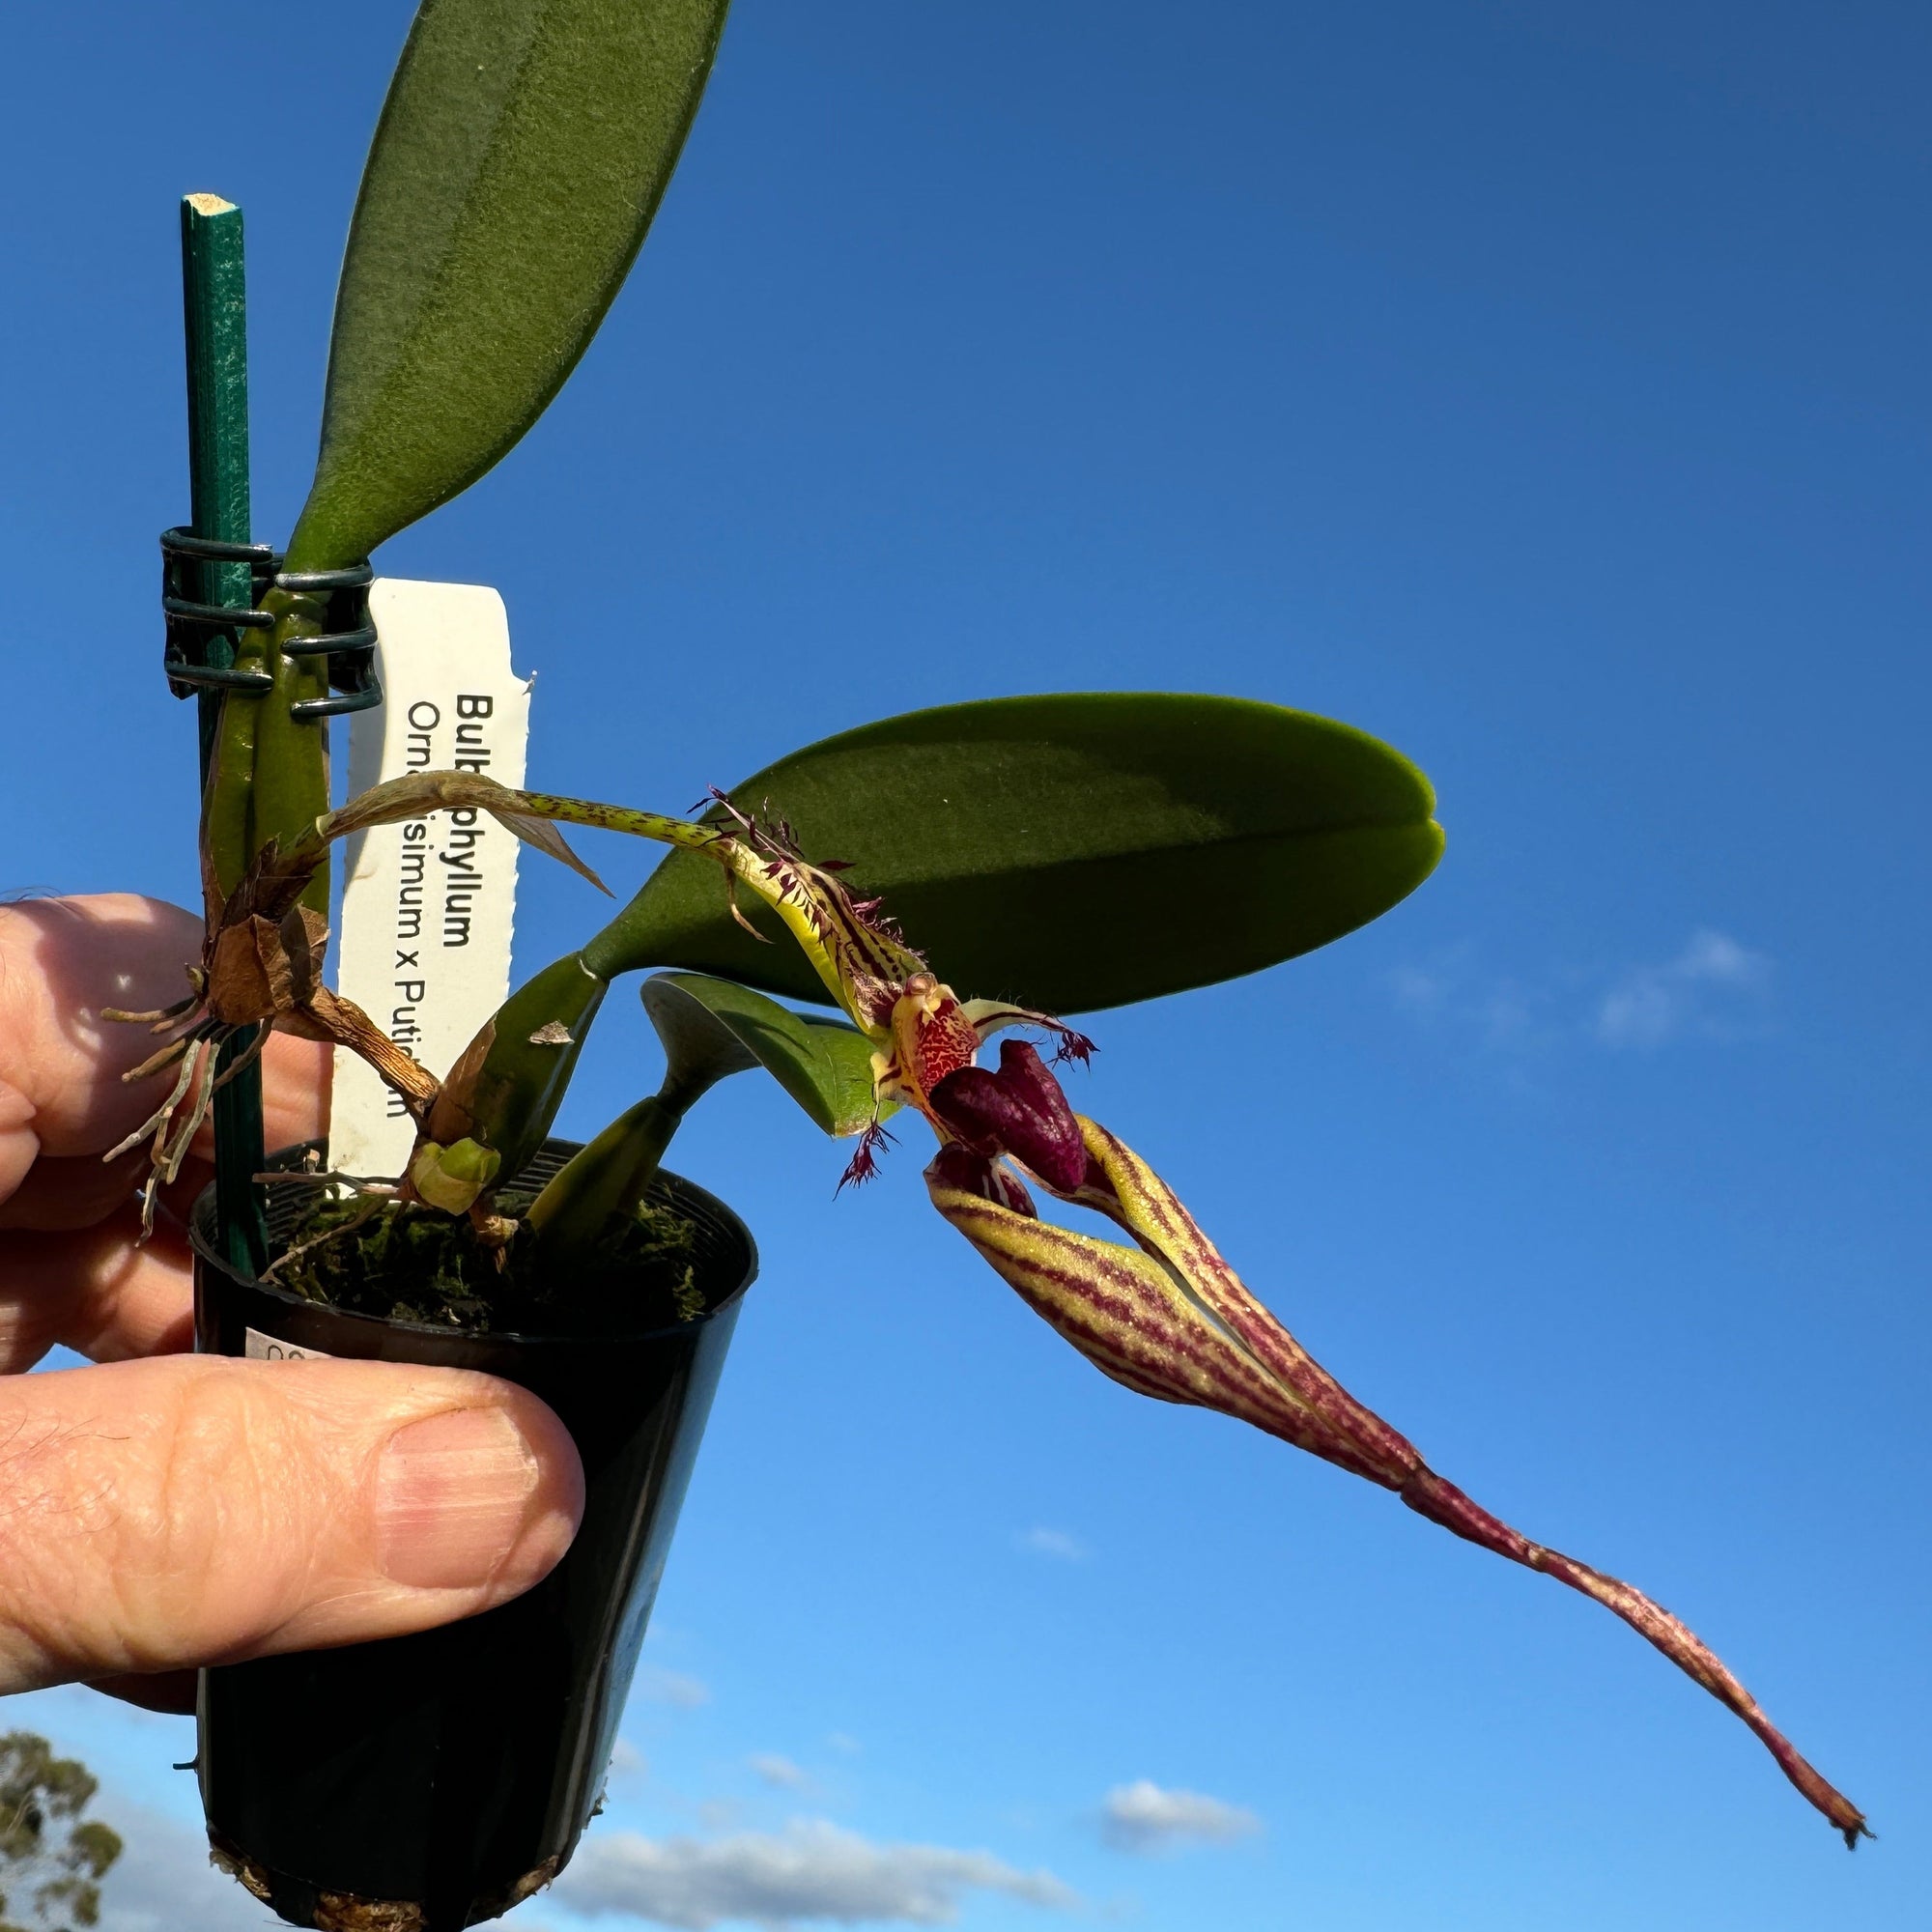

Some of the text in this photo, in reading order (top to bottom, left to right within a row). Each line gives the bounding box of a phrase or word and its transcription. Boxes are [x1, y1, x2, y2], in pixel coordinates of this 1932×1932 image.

[440, 695, 493, 947] Bulbphyllum
[395, 950, 419, 969] x
[386, 980, 425, 1118] Putim
